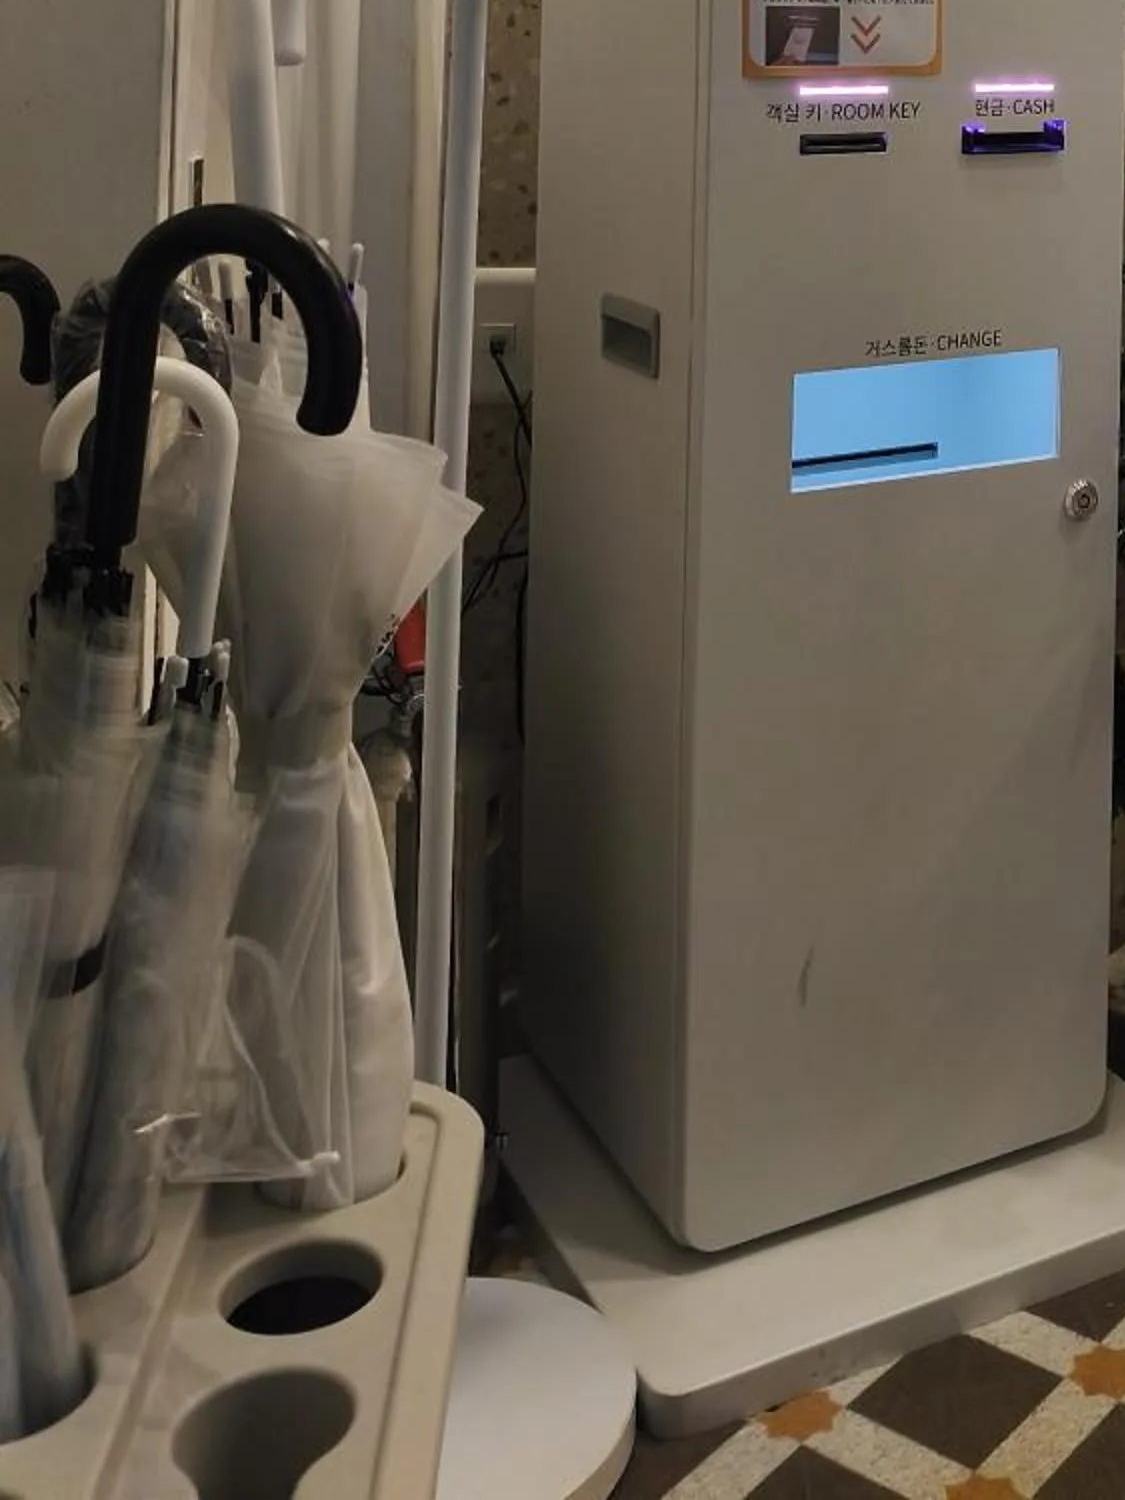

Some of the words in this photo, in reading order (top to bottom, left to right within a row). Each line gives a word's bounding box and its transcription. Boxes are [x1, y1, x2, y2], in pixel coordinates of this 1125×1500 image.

[766, 102, 800, 123] 객실
[831, 102, 886, 121] ROOM
[889, 102, 921, 119] KEY
[1012, 98, 1055, 116] CASH
[936, 329, 1002, 351] CHANGE
